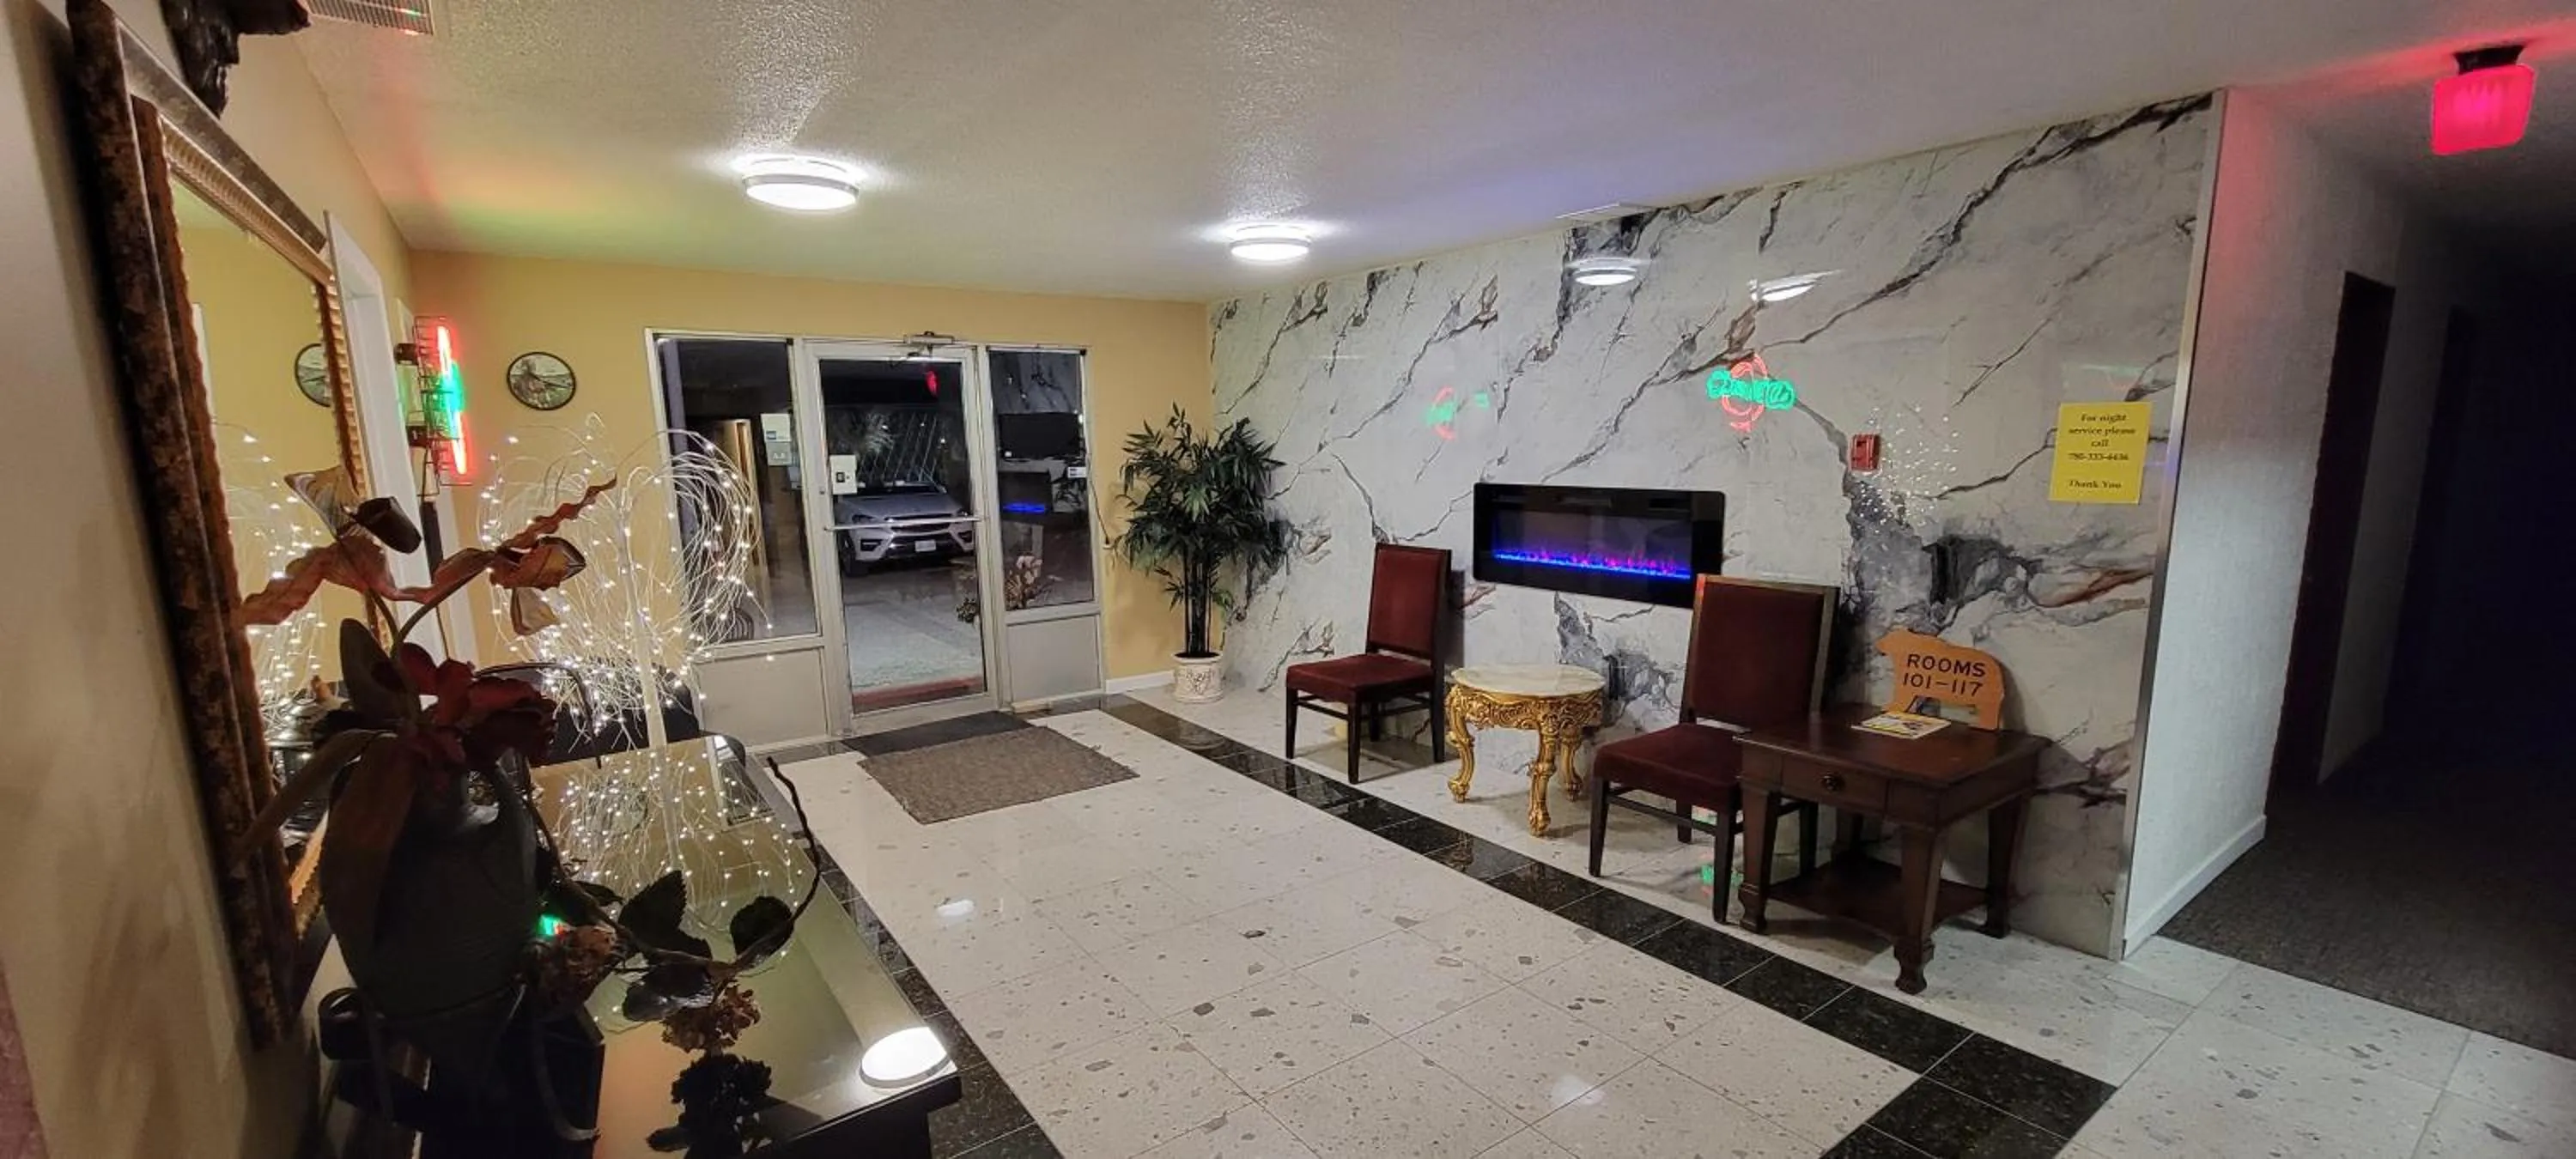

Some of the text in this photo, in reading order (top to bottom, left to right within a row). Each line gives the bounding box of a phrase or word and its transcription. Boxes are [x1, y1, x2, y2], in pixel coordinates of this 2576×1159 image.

[2099, 414, 2127, 423] night
[2105, 426, 2136, 436] please
[2091, 439, 2109, 447] call
[2069, 480, 2122, 488] Thank You
[1907, 653, 1986, 677] ROOMS
[1903, 672, 1984, 696] 101-117
